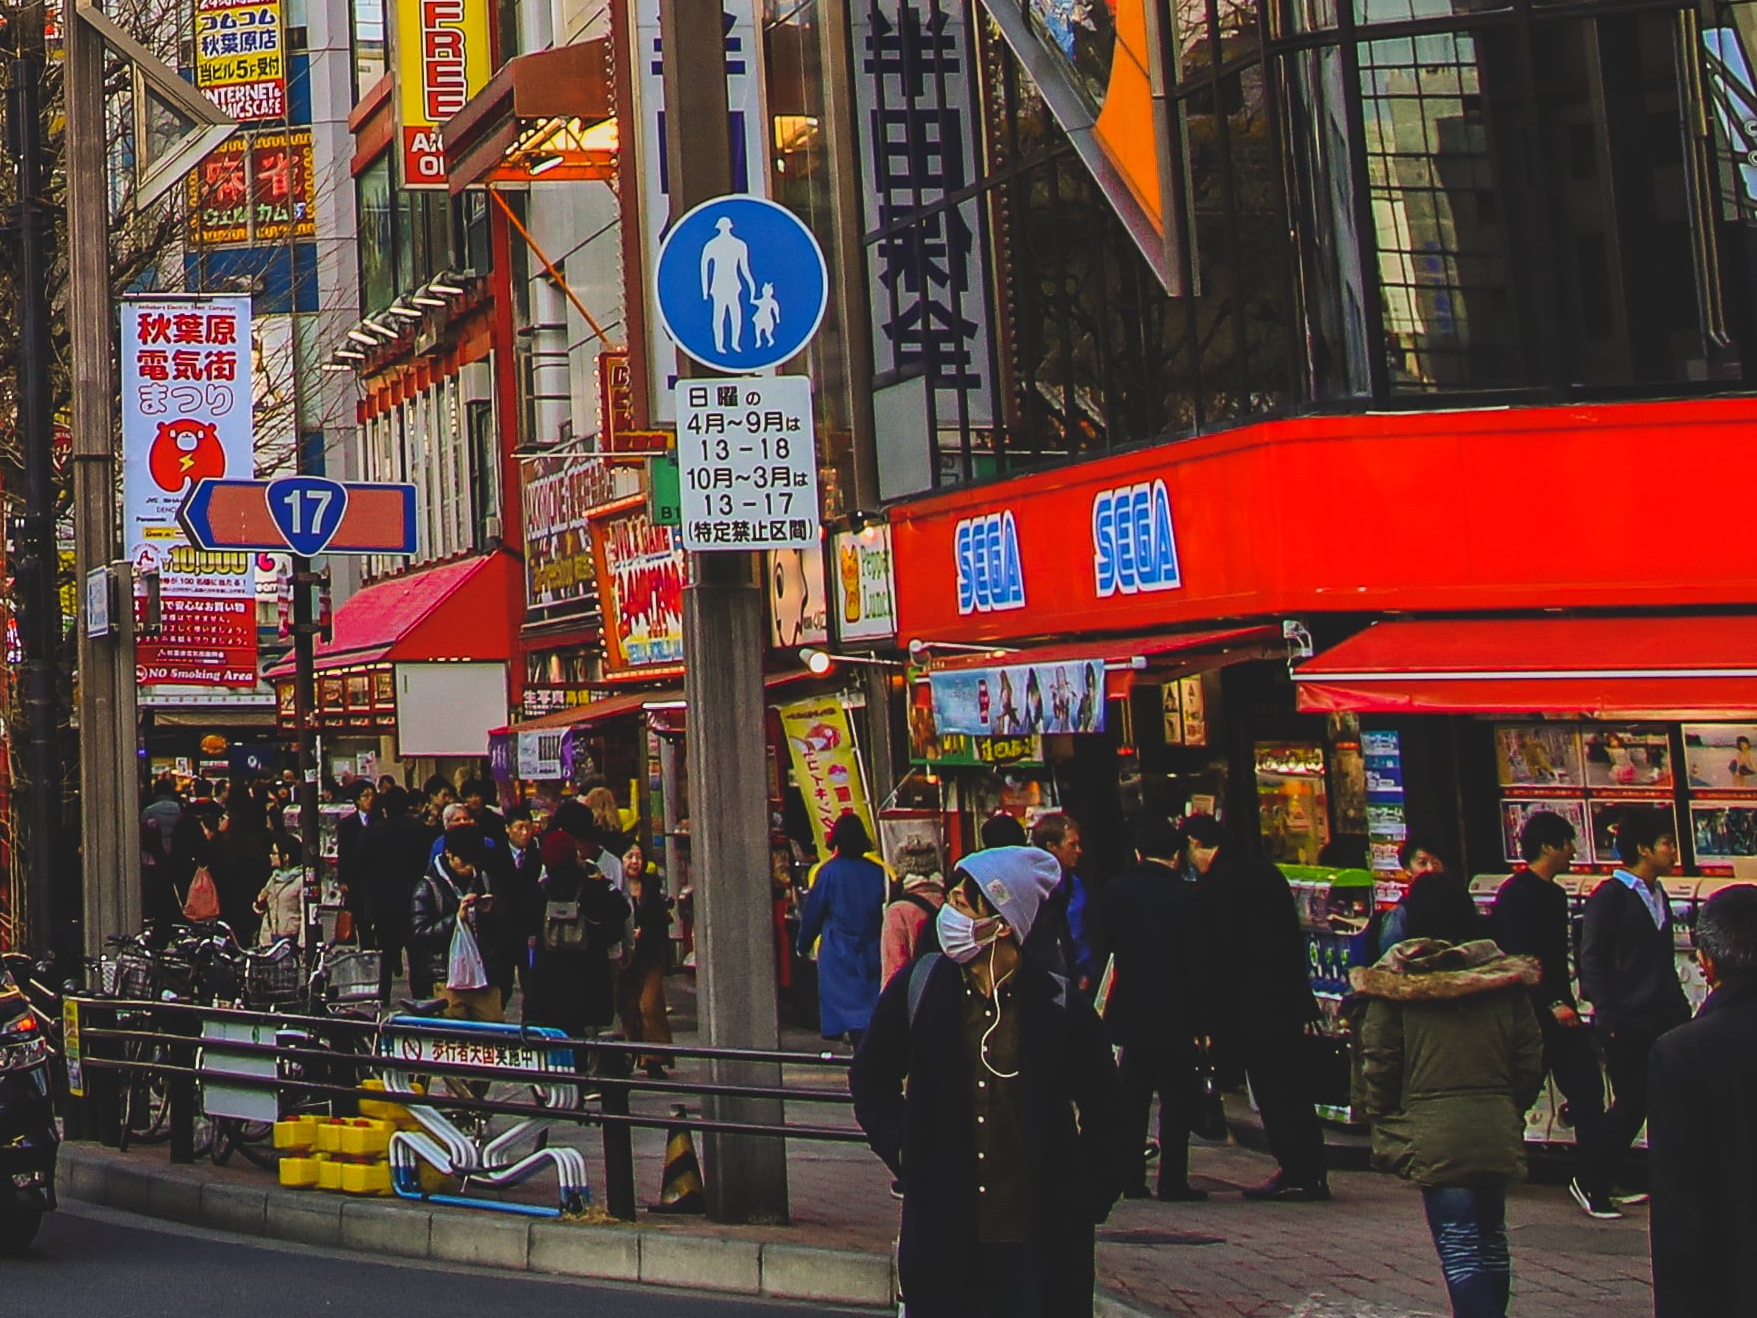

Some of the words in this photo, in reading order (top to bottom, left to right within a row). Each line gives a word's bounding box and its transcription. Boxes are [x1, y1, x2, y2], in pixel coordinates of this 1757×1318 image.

[201, 9, 276, 31] コムコム
[202, 29, 277, 57] 秋葉原店
[137, 314, 237, 345] 秋葉原
[137, 349, 236, 381] 電気街
[139, 384, 233, 416] まつり
[689, 386, 762, 408] 日曜の
[285, 490, 333, 535] 17
[688, 521, 814, 547] (特定禁止区間)
[1093, 479, 1182, 599] SEGA
[955, 509, 1027, 615] SEGA
[149, 668, 168, 681] NO
[170, 667, 221, 683] Smoking
[223, 669, 254, 683] Area
